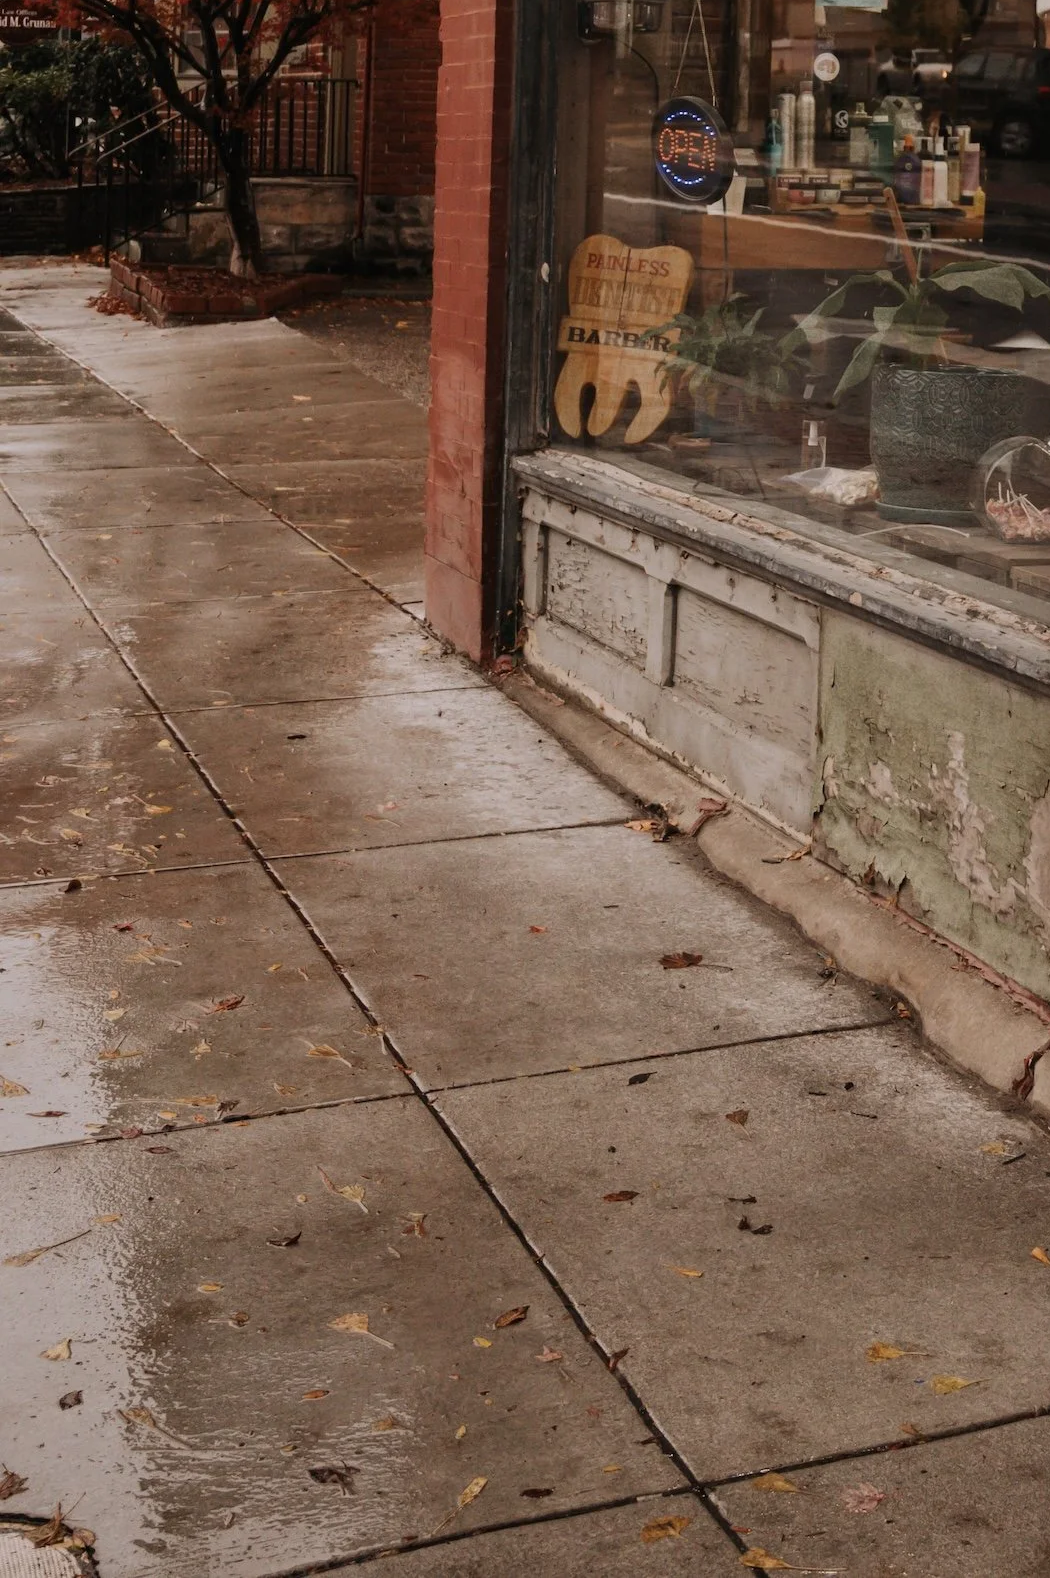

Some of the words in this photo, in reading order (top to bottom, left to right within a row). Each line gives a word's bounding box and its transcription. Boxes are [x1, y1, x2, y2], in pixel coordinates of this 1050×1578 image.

[9, 15, 21, 28] M.
[659, 126, 717, 172] OPEN
[586, 252, 671, 278] PAINLESS
